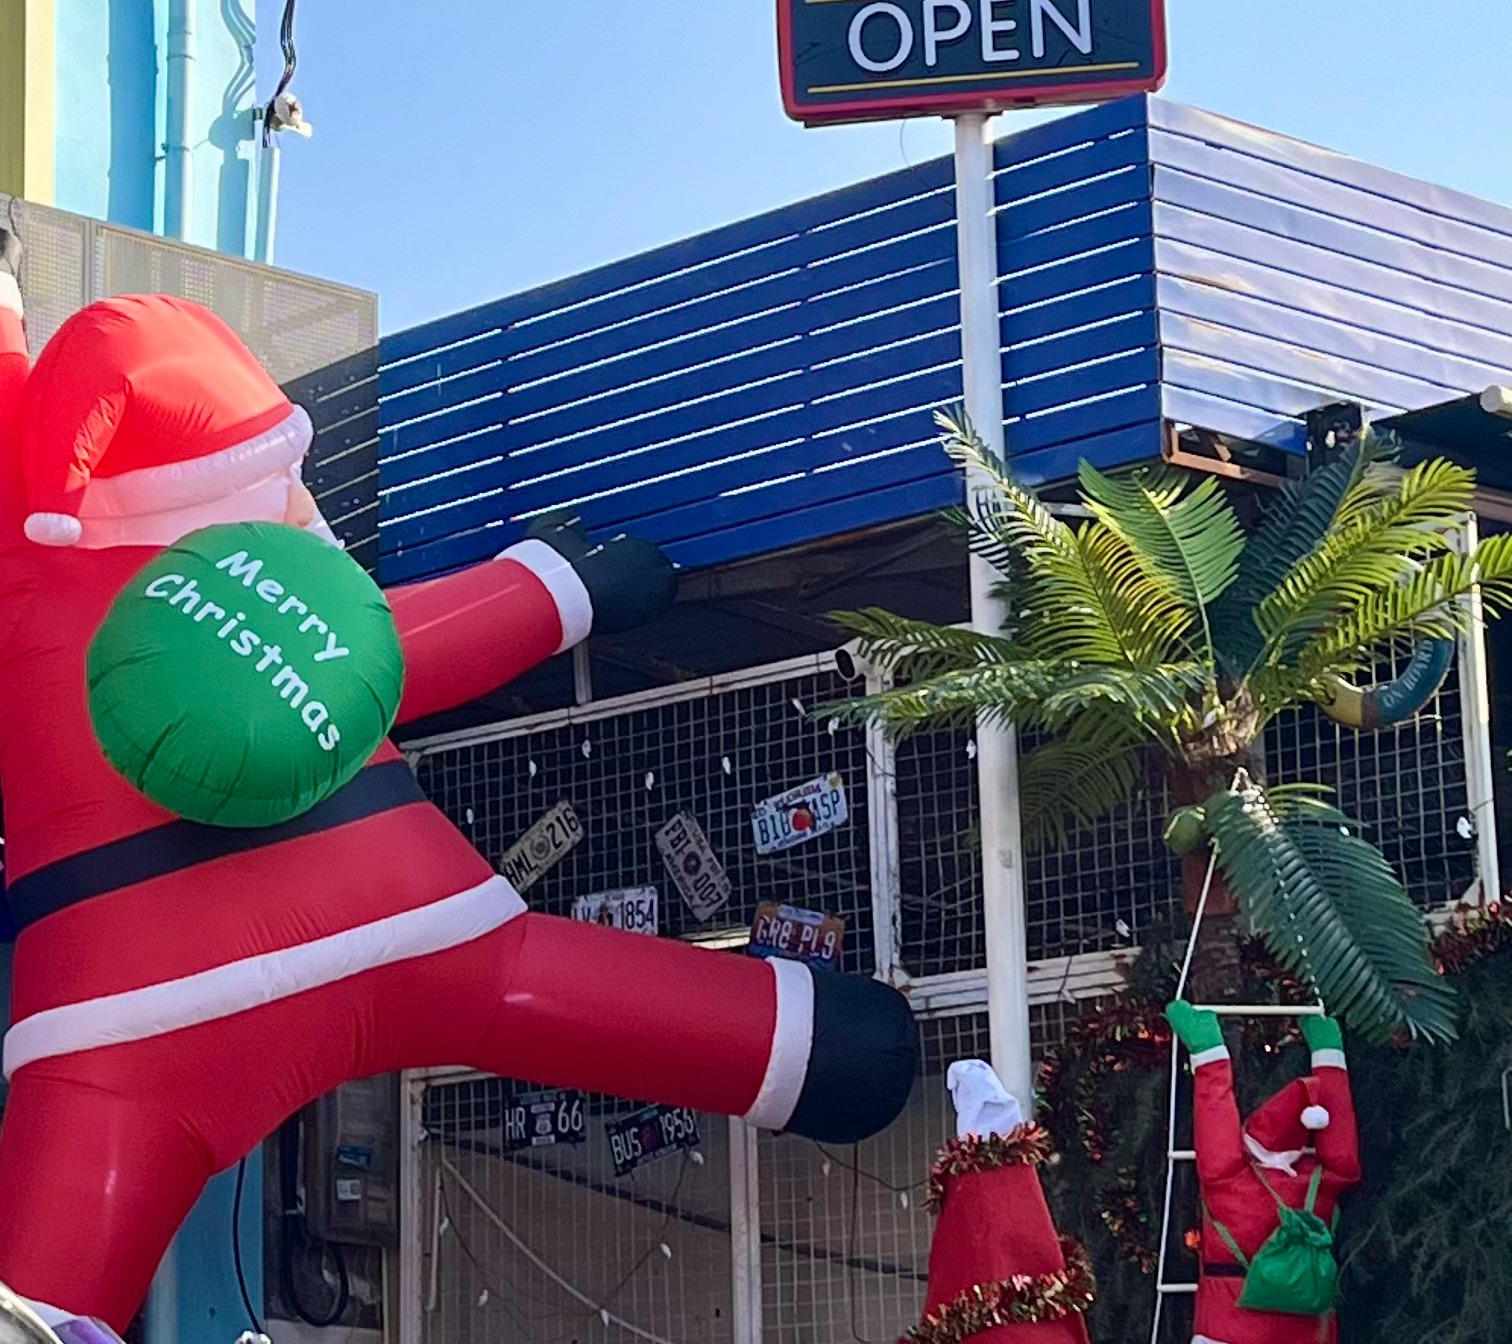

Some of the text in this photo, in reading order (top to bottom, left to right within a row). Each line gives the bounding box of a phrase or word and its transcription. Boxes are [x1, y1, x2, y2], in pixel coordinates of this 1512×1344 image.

[215, 550, 350, 662] Merry
[144, 573, 341, 751] Christmas
[545, 806, 579, 850] 216
[692, 872, 723, 908] 007
[504, 1106, 526, 1141] HR
[557, 1099, 583, 1134] 66
[611, 1126, 643, 1165] BUS
